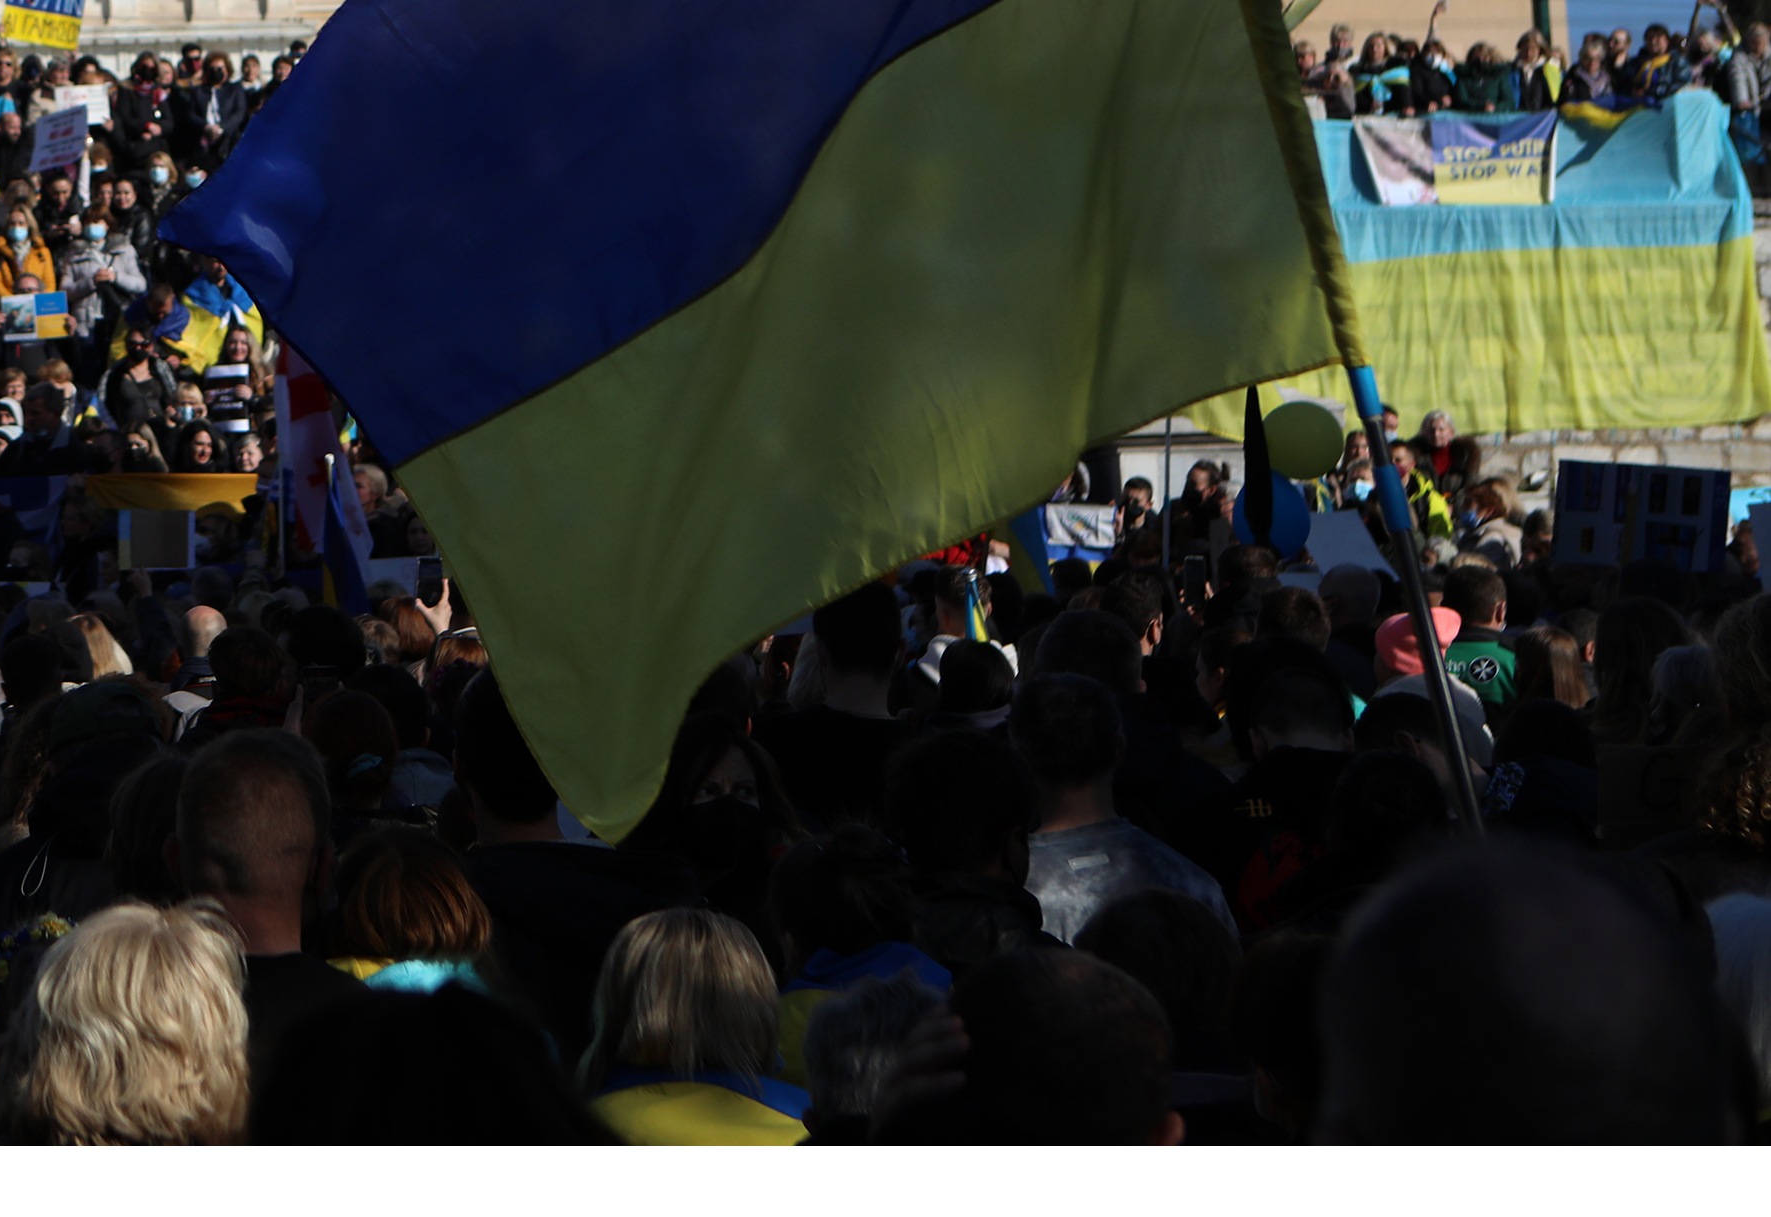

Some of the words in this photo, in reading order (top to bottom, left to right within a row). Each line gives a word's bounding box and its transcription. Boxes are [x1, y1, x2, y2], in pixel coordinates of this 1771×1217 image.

[1442, 145, 1493, 162] STOP
[1450, 163, 1497, 180] STOP
[1505, 161, 1539, 178] WA
